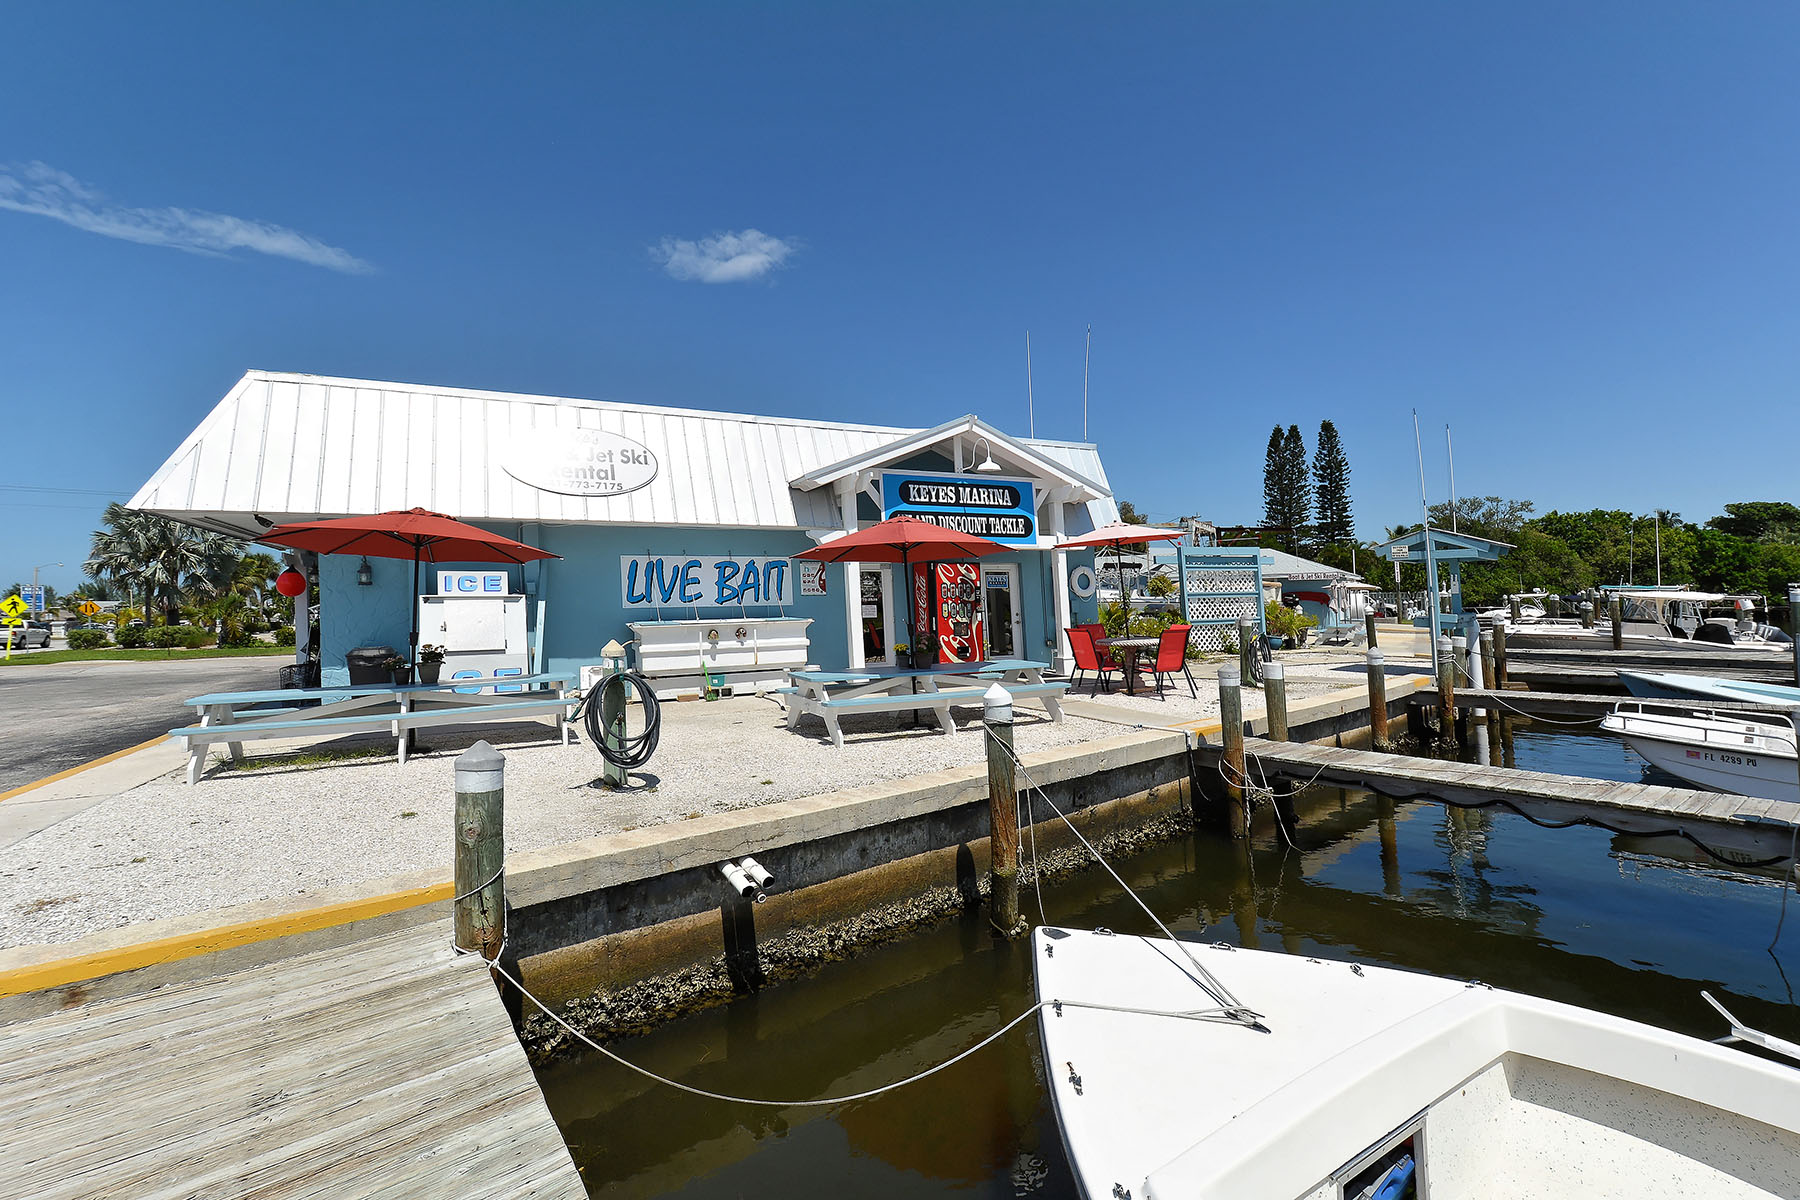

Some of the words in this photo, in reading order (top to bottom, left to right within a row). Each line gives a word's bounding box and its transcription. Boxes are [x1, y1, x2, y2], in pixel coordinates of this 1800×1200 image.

[586, 447, 614, 463] Jet
[620, 449, 650, 466] Ski
[552, 464, 616, 481] ental
[908, 484, 956, 503] KEYES
[959, 486, 1012, 506] MARINA
[938, 515, 987, 534] DISCOUNT
[989, 517, 1025, 535] TACKLE
[444, 575, 503, 592] ICE
[626, 558, 703, 604] LIVE
[714, 558, 789, 605] BAIT
[1704, 753, 1716, 761] FL
[1720, 755, 1742, 765] 4289
